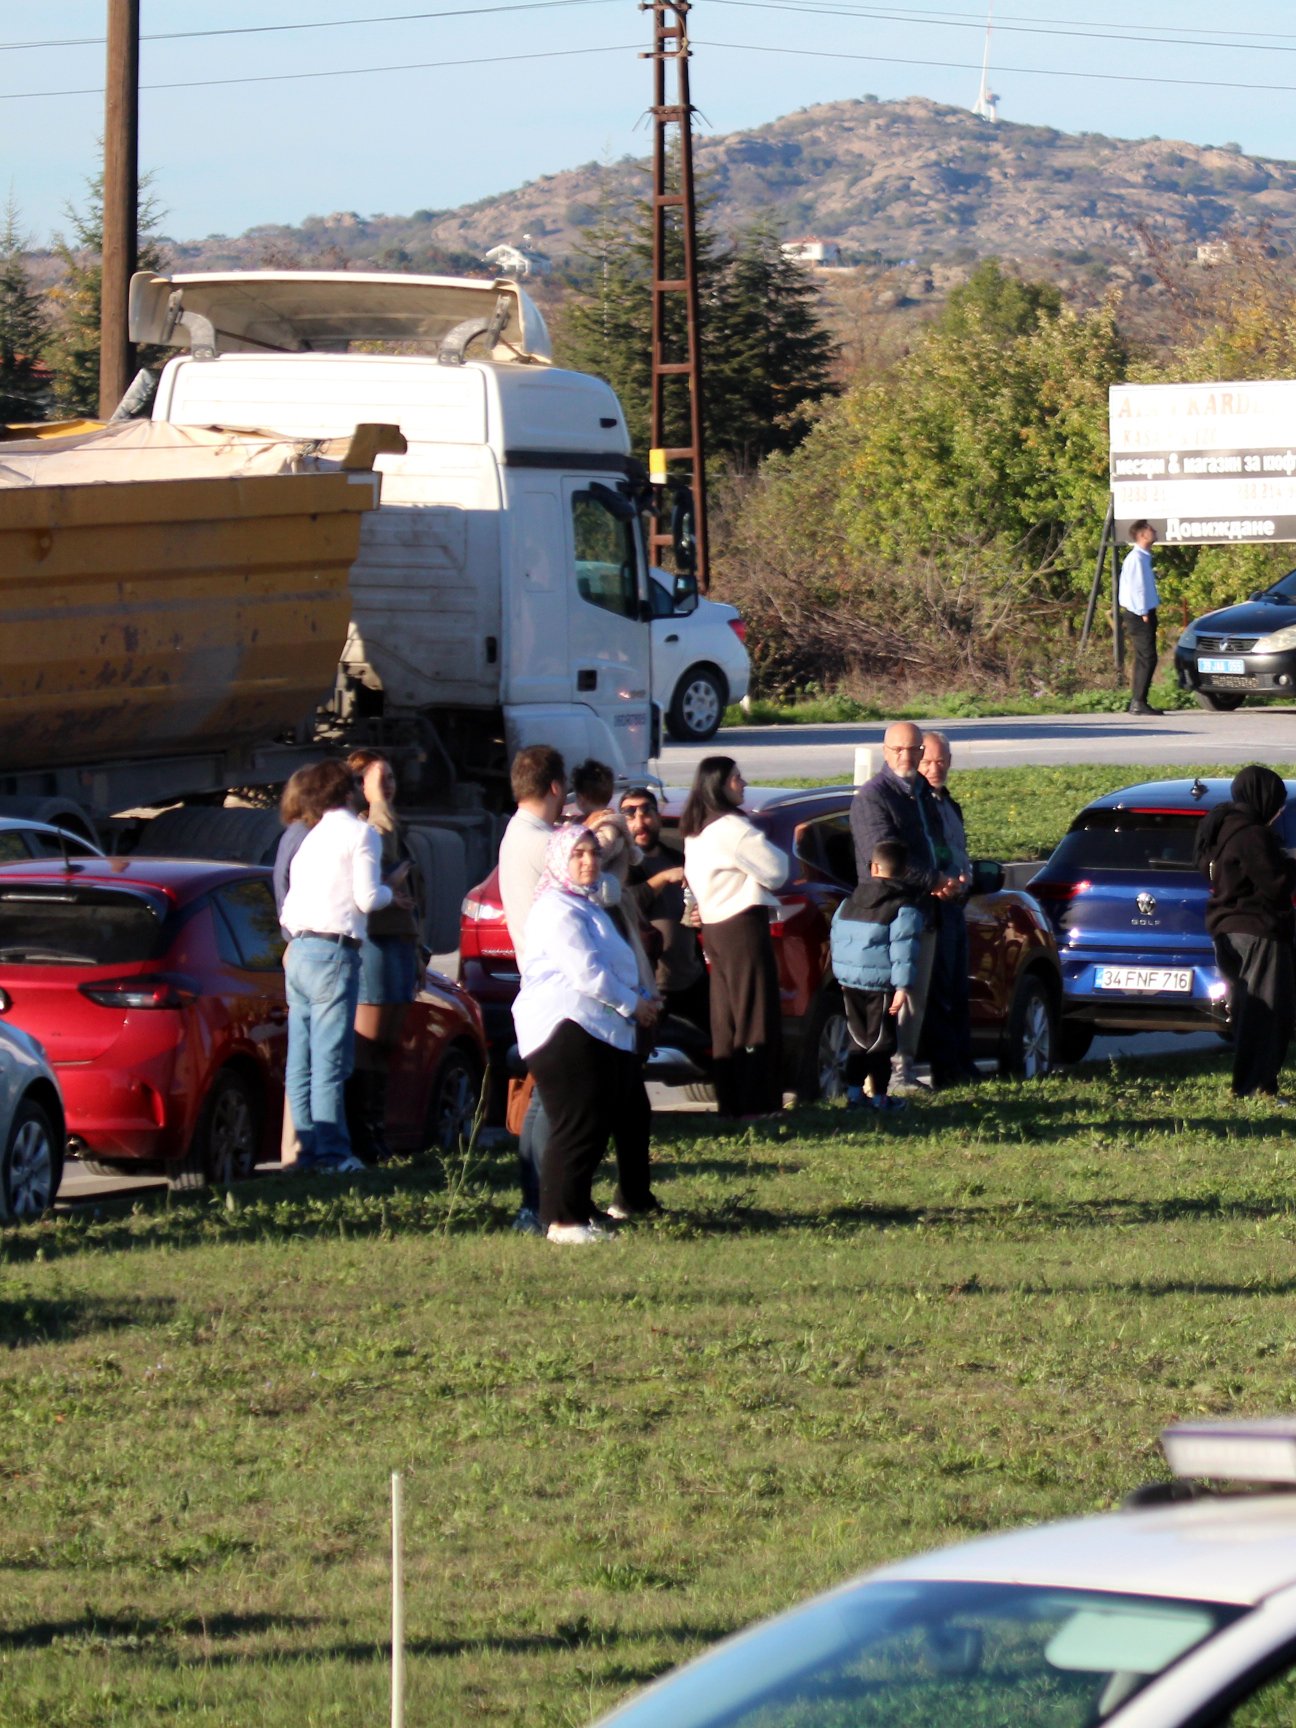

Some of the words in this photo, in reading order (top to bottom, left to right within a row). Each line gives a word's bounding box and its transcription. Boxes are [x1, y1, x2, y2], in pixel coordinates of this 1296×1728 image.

[1168, 452, 1180, 474] &
[1244, 455, 1260, 471] за
[1165, 518, 1276, 541] Довиждане
[1131, 918, 1160, 926] GOLF
[1104, 970, 1121, 986] 34
[1126, 971, 1158, 987] FNF
[1163, 972, 1188, 989] 716
